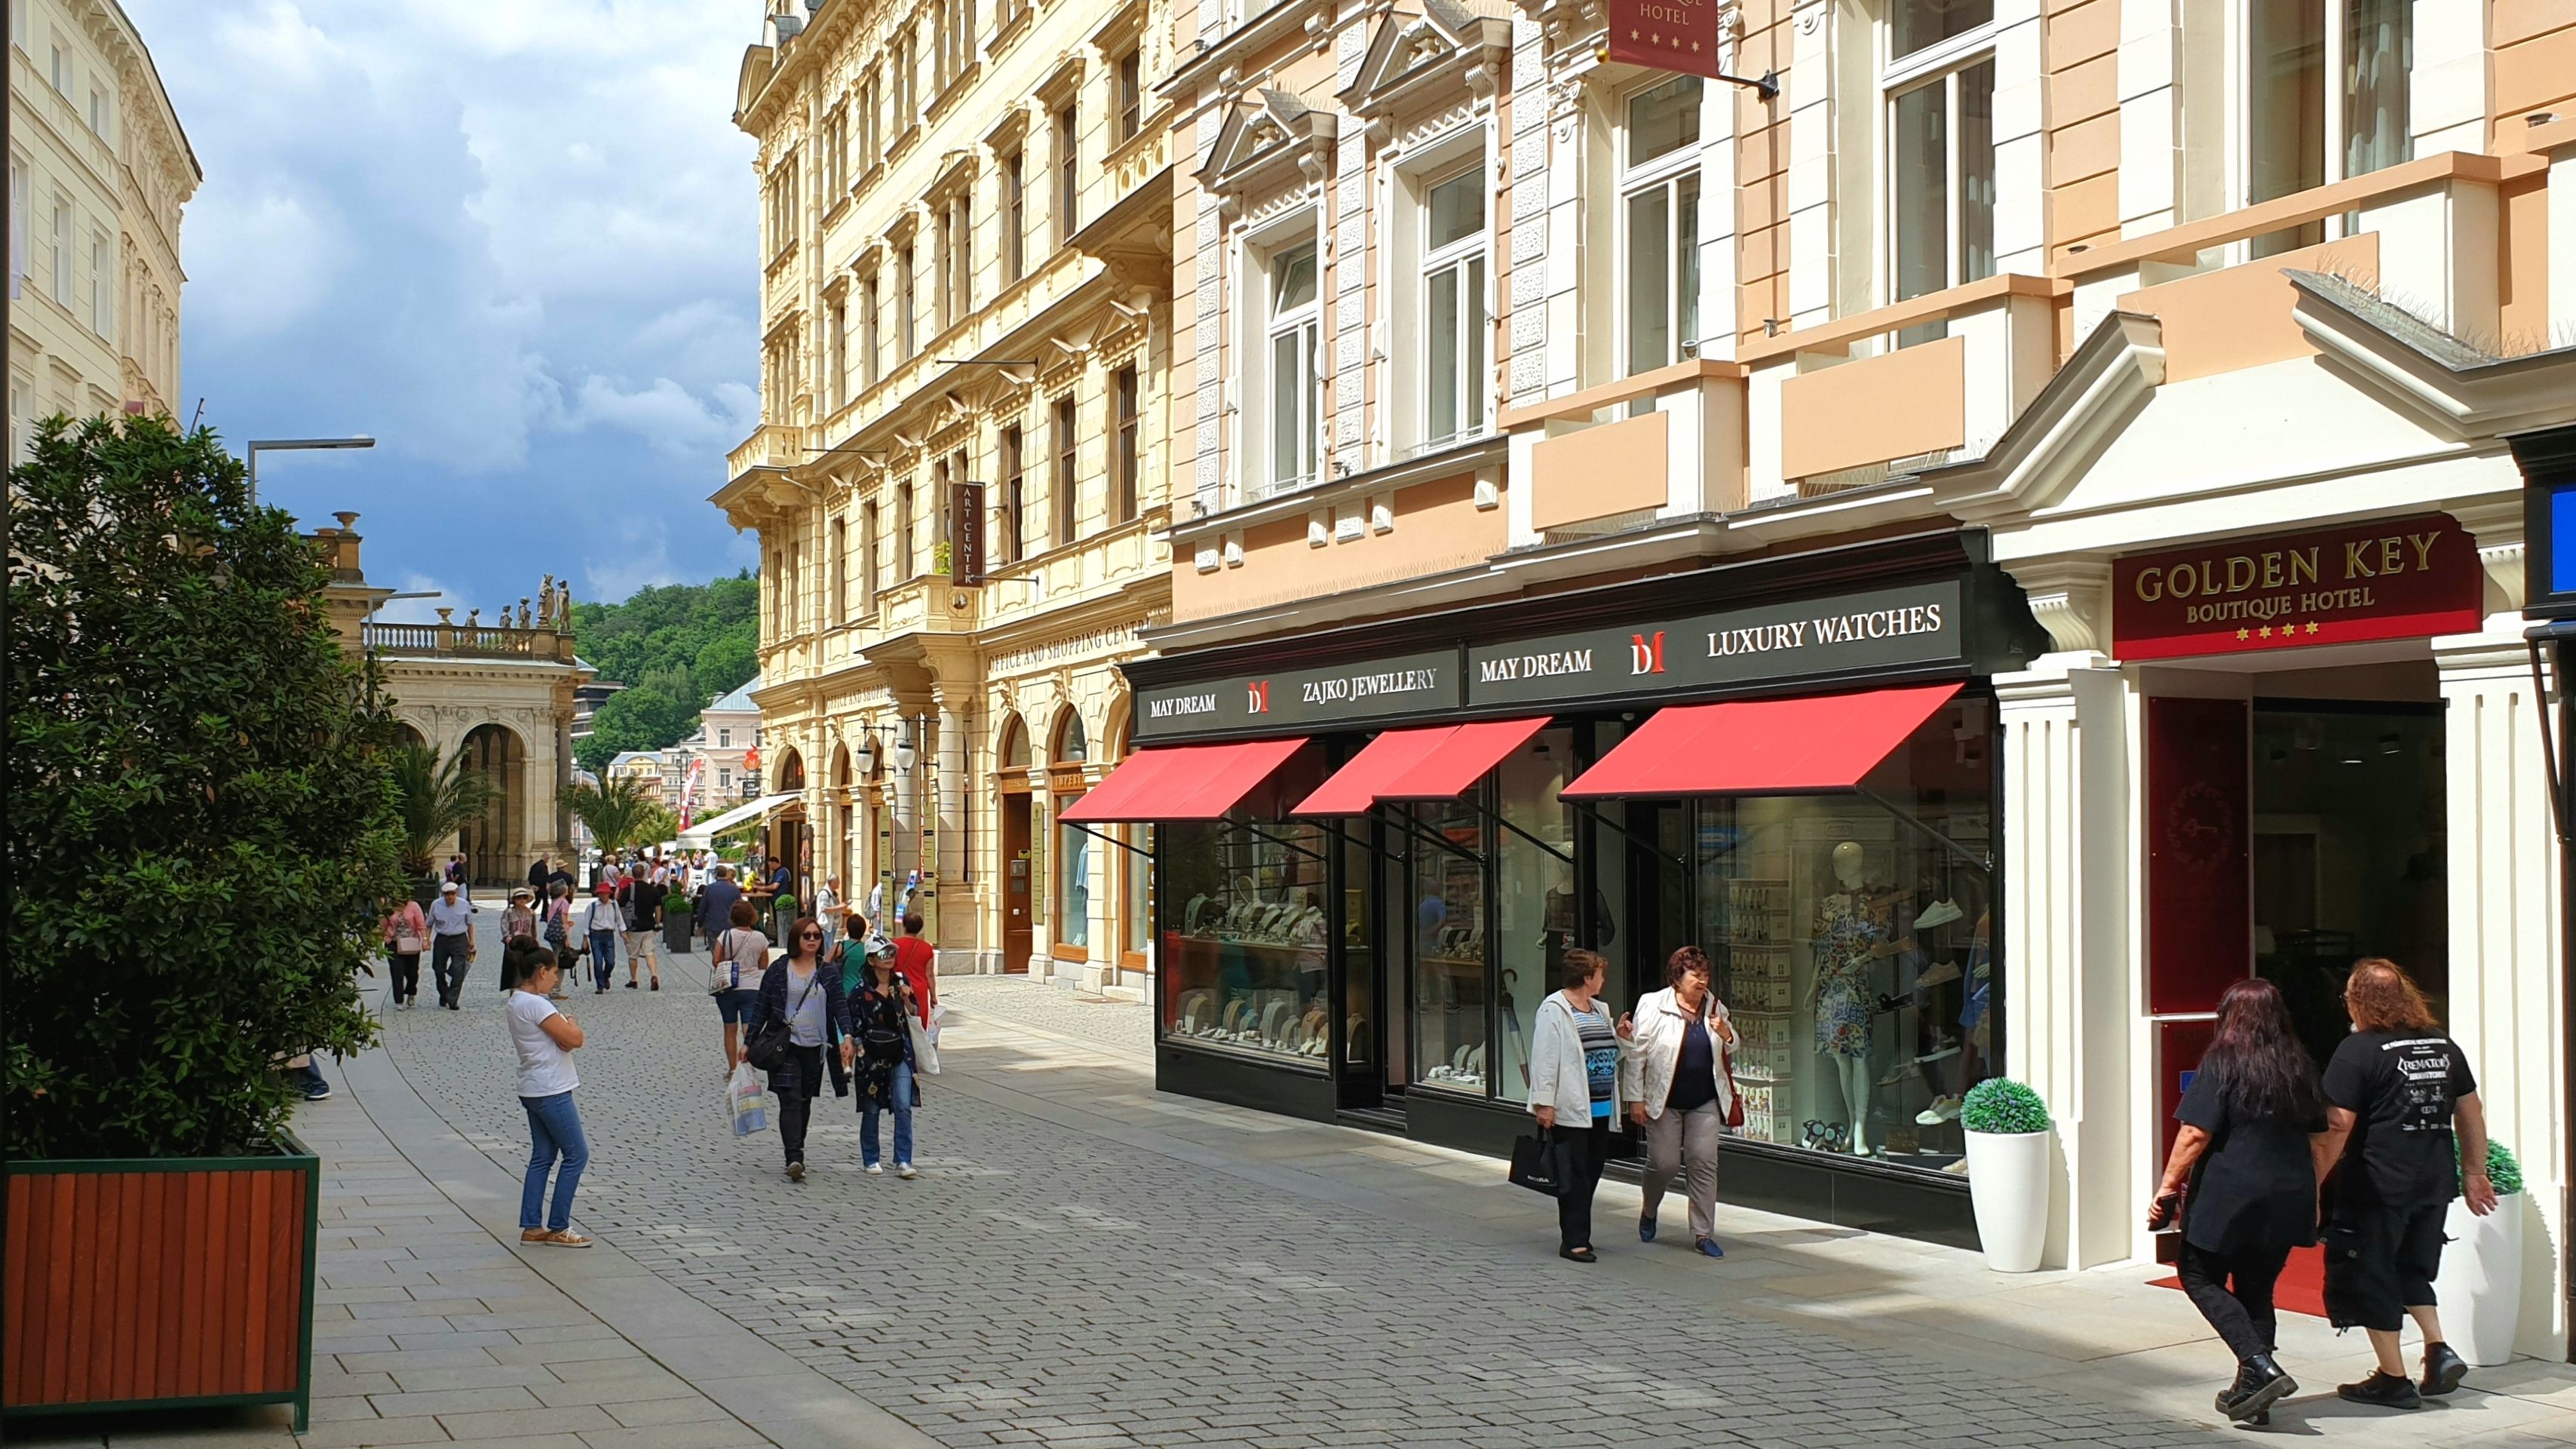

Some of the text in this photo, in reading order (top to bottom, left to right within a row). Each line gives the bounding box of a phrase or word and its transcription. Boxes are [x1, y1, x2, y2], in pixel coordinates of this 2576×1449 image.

[1640, 3, 1689, 26] HOTEL
[963, 488, 973, 585] ART CENTER
[2135, 530, 2442, 603] GOLDEN KEY
[2186, 587, 2375, 624] BOUTIQUE HOTEL
[1707, 603, 1941, 658] LUXURY WATCHES
[988, 649, 1021, 674] OFFICE
[1023, 643, 1044, 666] AND
[1047, 629, 1102, 660] SHOPPING
[1480, 649, 1592, 682] MAY DREAM
[826, 692, 847, 711] OFFICE
[848, 689, 862, 705] AND
[1302, 668, 1437, 705] ZAJKO JEWELLERY
[1150, 694, 1216, 717] MAY DREAM
